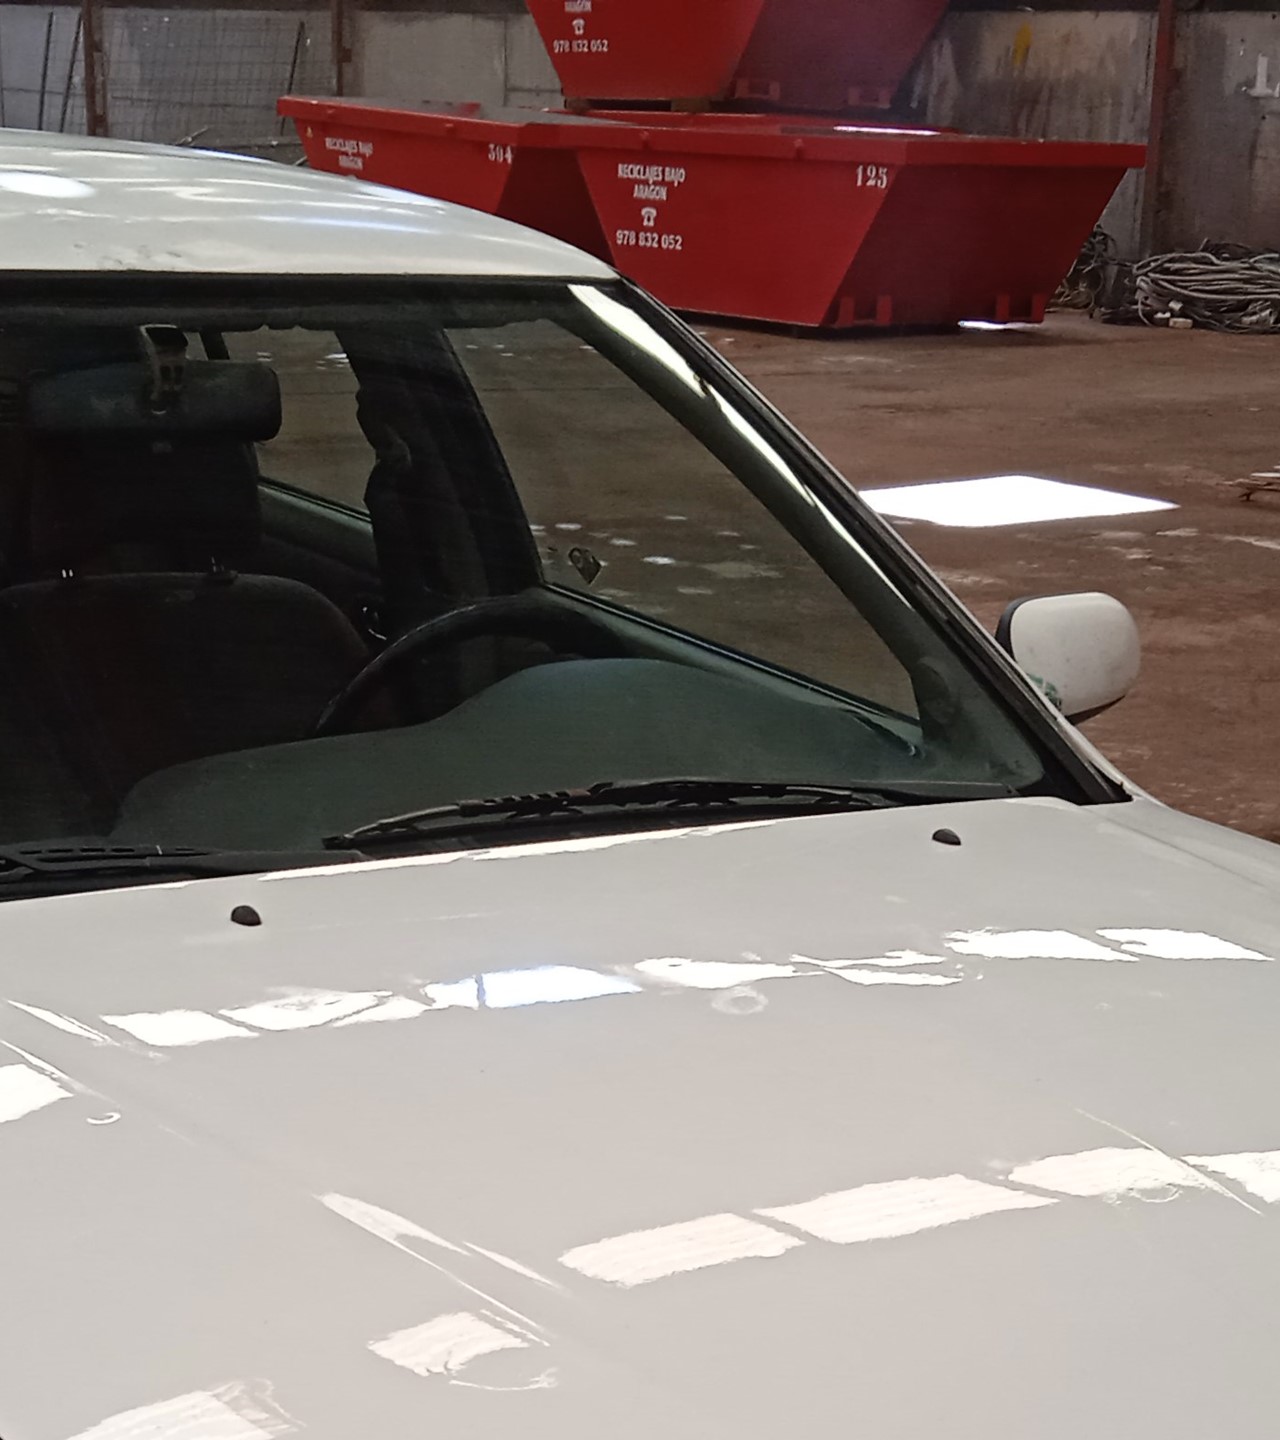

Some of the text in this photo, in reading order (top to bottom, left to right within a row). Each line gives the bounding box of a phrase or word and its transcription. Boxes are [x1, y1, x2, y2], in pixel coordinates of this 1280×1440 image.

[488, 143, 513, 164] 304
[618, 163, 686, 187] RECICLAJES BAJO
[856, 164, 888, 189] 125
[616, 229, 683, 250] 978 832 052
